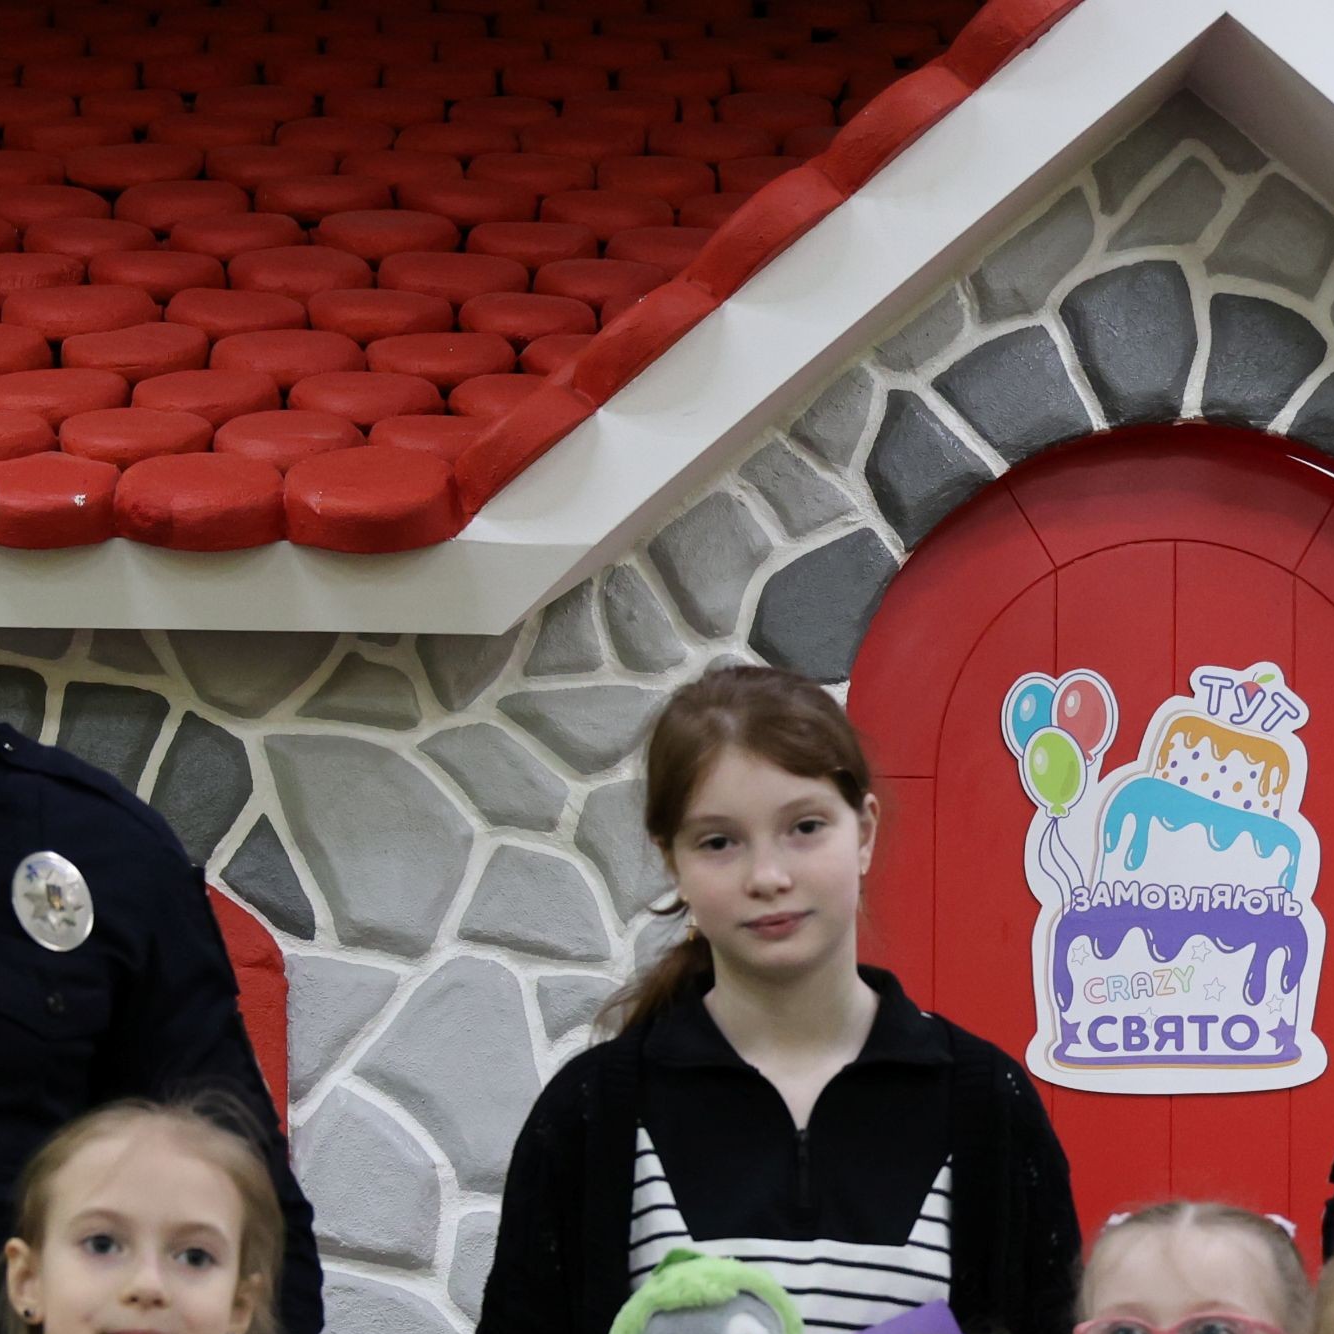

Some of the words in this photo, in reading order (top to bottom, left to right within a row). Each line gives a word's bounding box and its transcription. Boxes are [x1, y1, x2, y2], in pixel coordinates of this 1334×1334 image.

[1200, 674, 1301, 732] ТУТ
[1072, 880, 1303, 918] ЗАМОВЛЯЮТЬ
[1084, 965, 1195, 1005] CRAZY
[1087, 1014, 1260, 1053] СВЯТО
